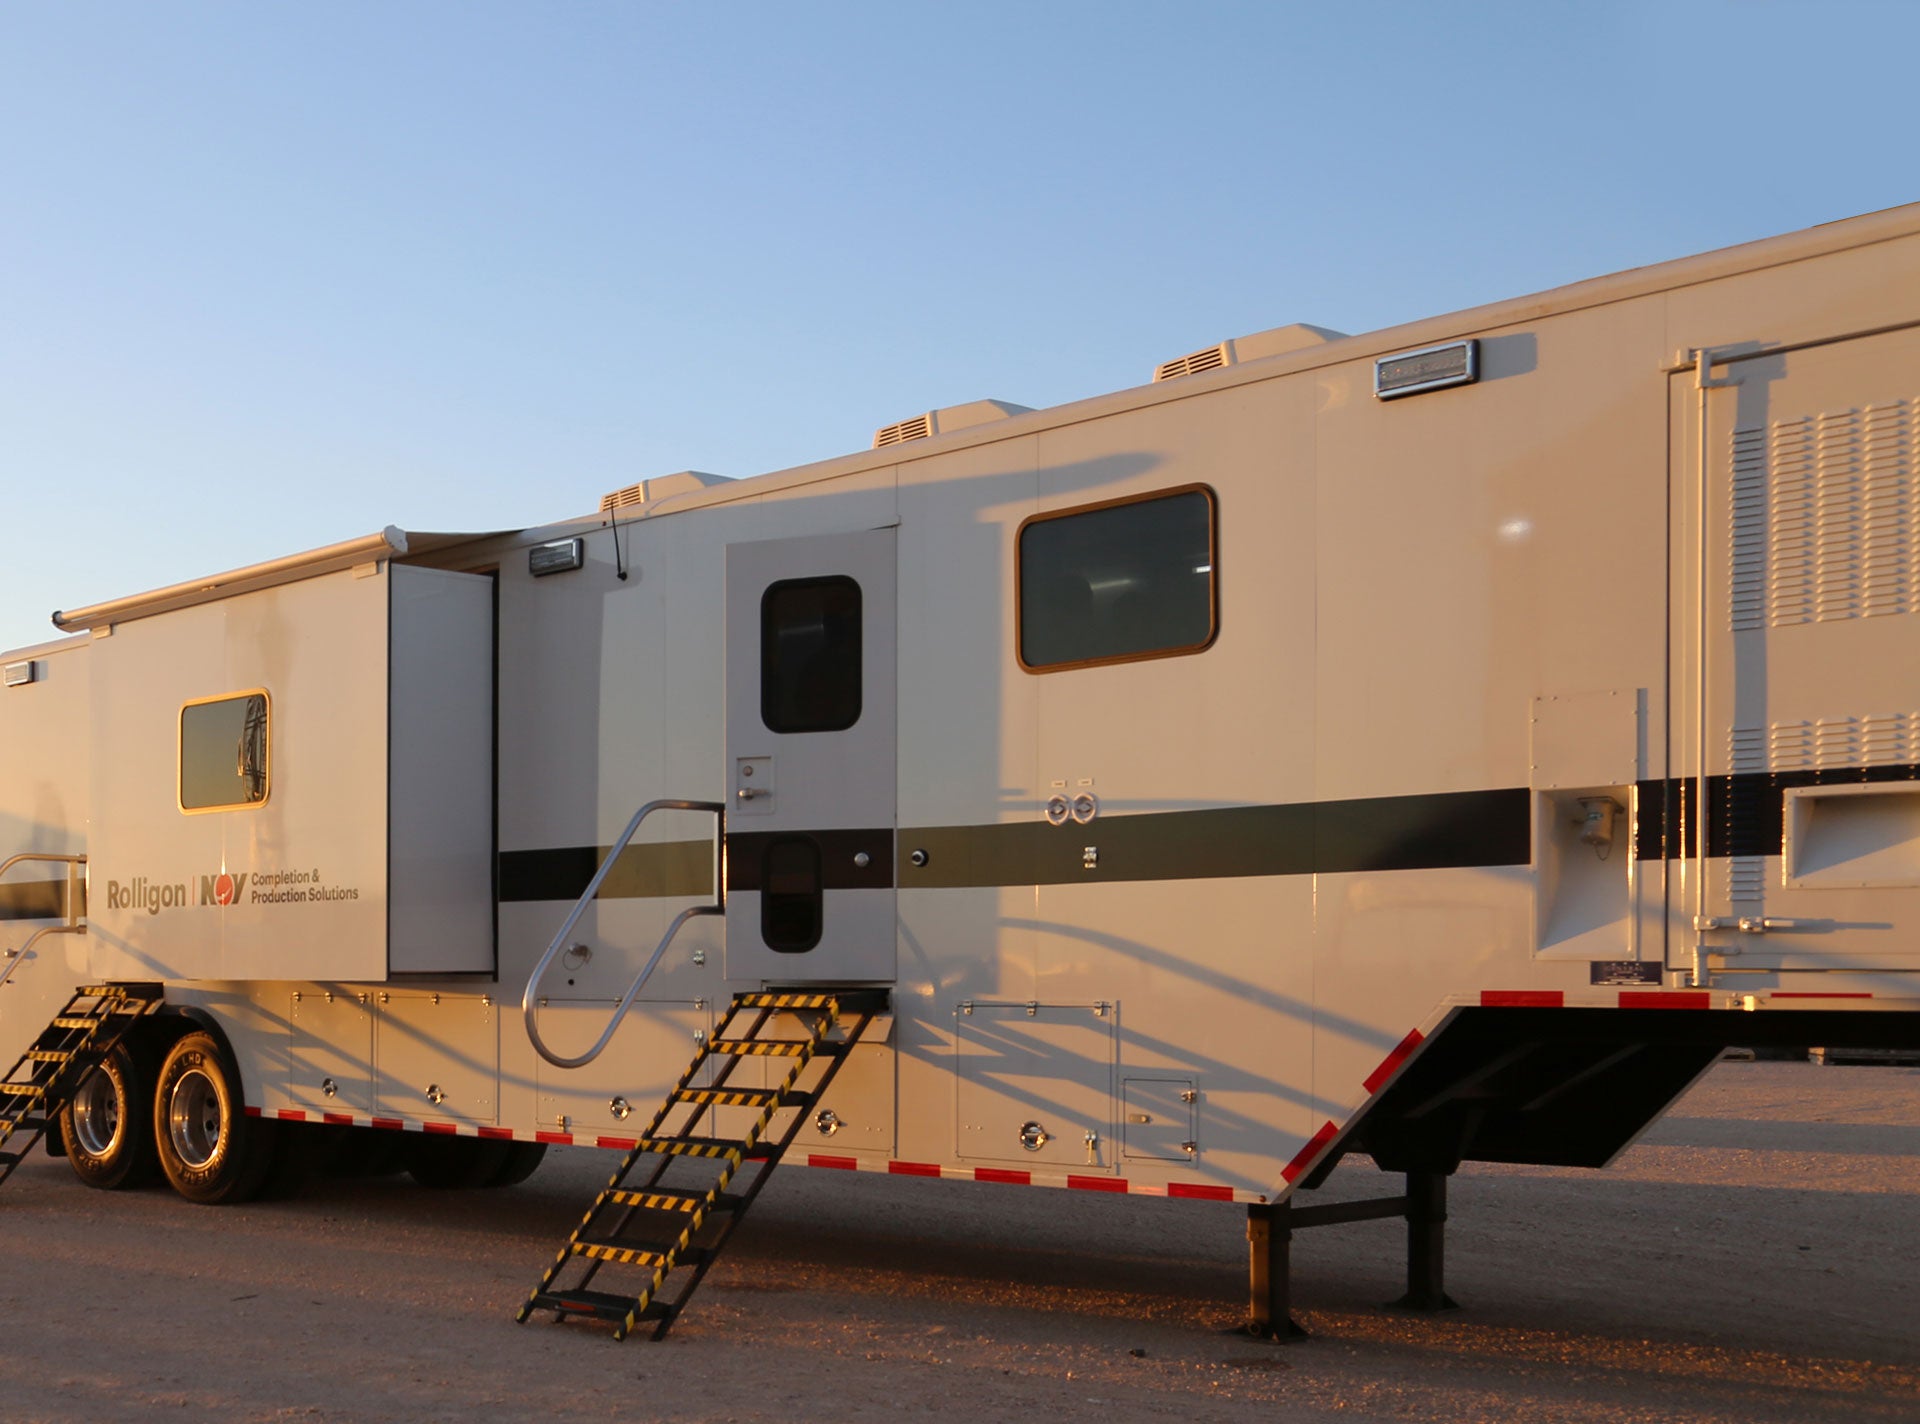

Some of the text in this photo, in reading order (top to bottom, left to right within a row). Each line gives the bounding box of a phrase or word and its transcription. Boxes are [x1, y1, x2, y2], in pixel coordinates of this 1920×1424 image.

[251, 868, 320, 889] Completion &
[107, 872, 248, 915] Rolligon NOV
[251, 886, 359, 905] Production Solutions
